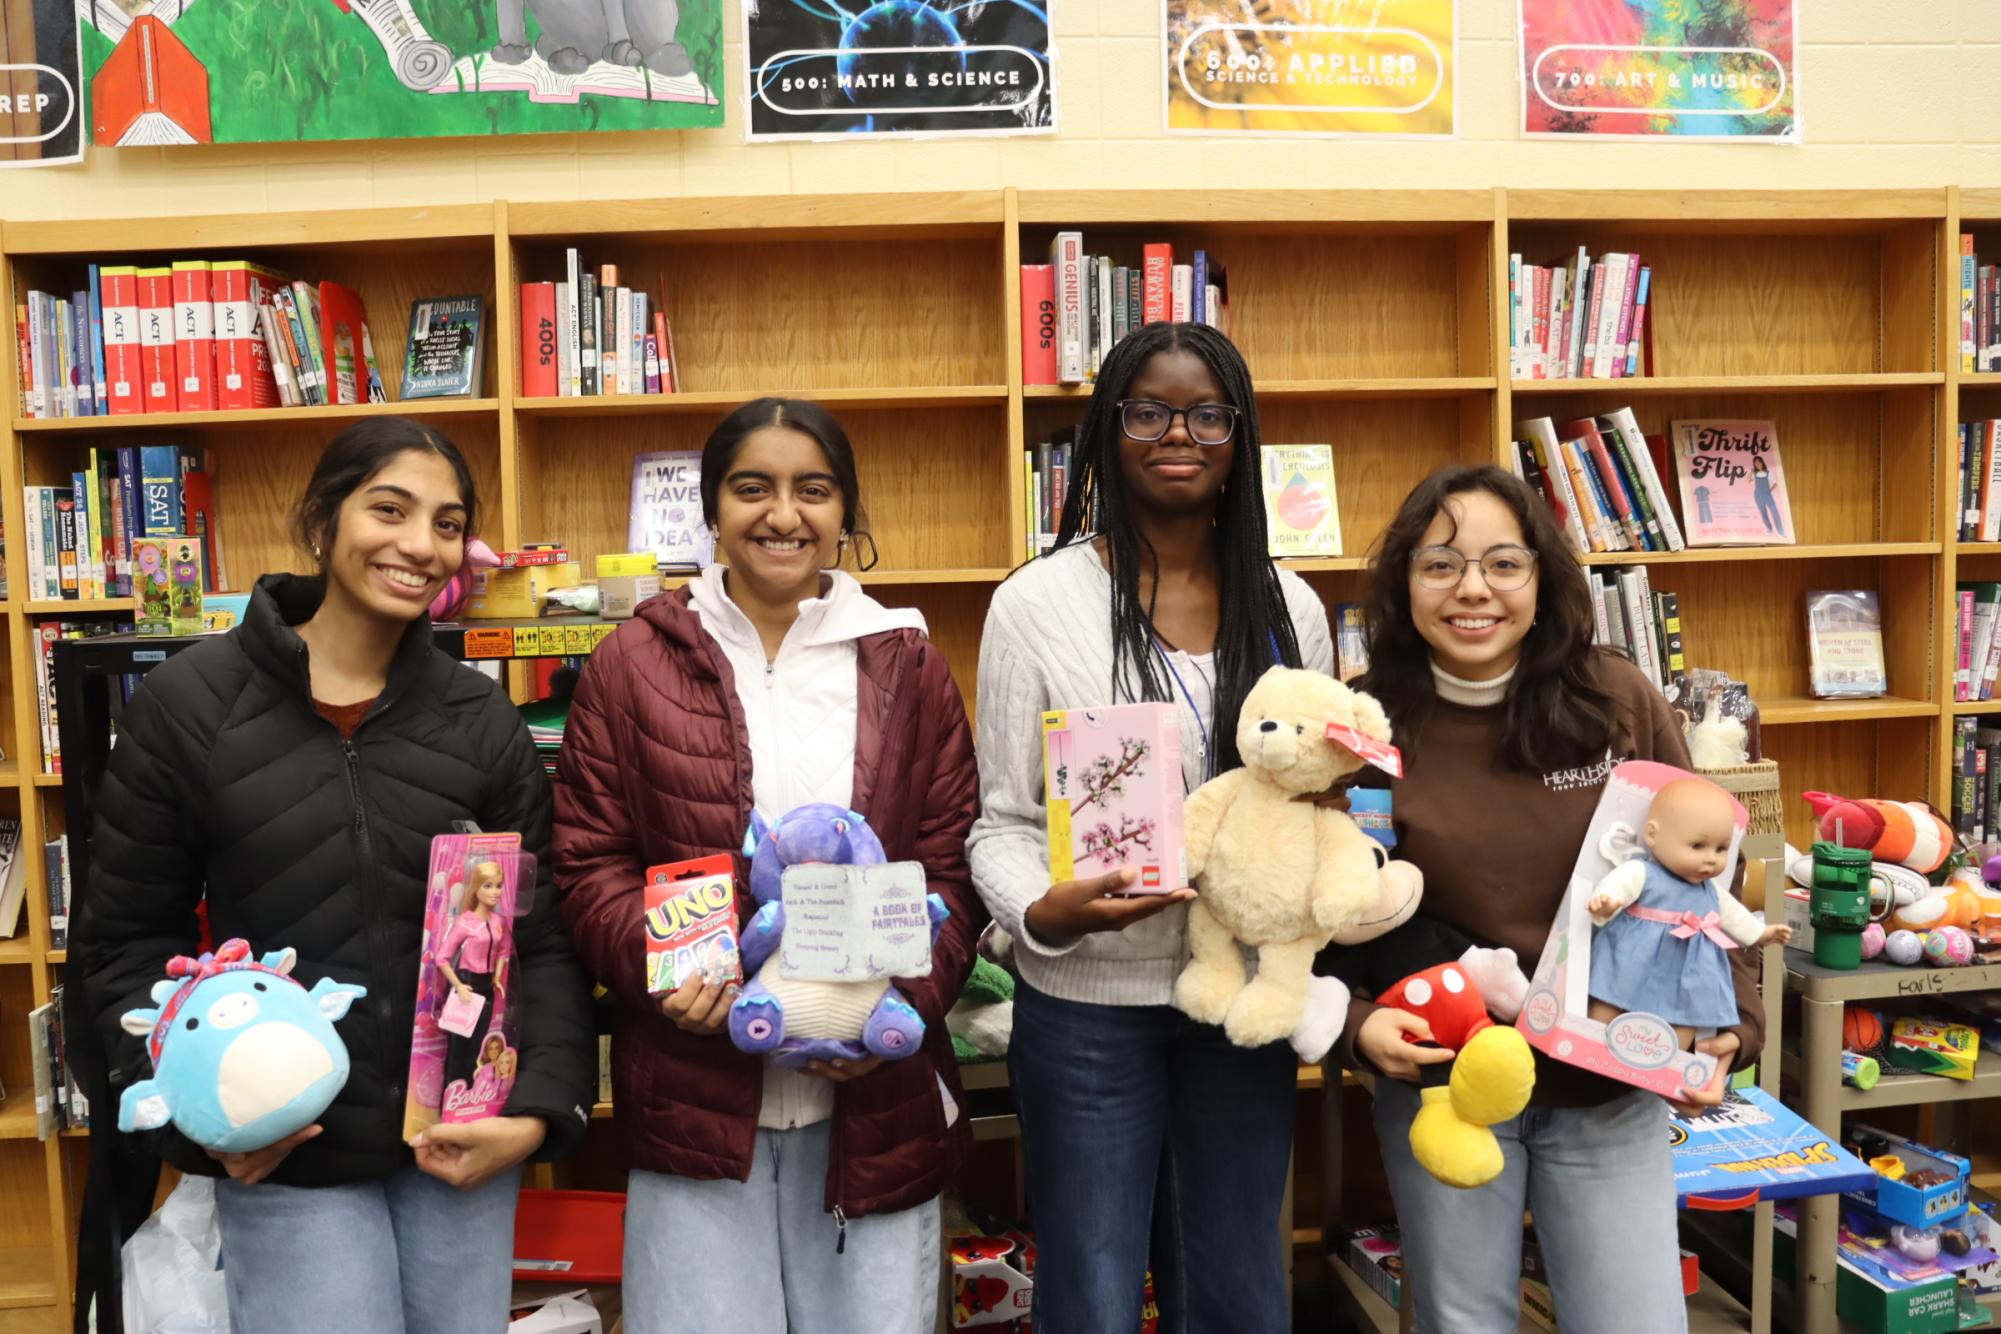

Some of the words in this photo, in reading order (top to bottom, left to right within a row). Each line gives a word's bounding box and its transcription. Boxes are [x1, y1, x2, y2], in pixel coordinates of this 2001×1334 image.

[1288, 53, 1417, 74] APPLIED
[781, 77, 828, 92] 500:
[837, 74, 896, 89] MATH
[905, 73, 919, 88] &
[927, 71, 1021, 87] SCIENCE
[1206, 70, 1279, 84] SCIENCE
[1286, 73, 1297, 84] &
[1304, 73, 1418, 87] TECHNOLOGY
[1554, 72, 1605, 87] 700:
[1615, 73, 1657, 88] ART
[1668, 75, 1681, 88] &
[1691, 74, 1764, 89] MUSIC
[1064, 264, 1079, 311] GENIUS
[416, 299, 477, 316] OUNTABLE
[114, 312, 124, 341] ACT
[150, 312, 160, 342] ACT
[186, 306, 196, 336] ACT
[226, 306, 236, 336] ACT
[1040, 300, 1054, 349] 600s
[1619, 306, 1628, 334] KITCHEN
[77, 318, 87, 363] Newcomers
[538, 318, 554, 366] 400s
[570, 320, 578, 350] ENGLISH
[1698, 427, 1771, 456] Thrift
[124, 474, 132, 488] SAT
[656, 466, 687, 482] WE
[1691, 455, 1747, 486] Flip
[74, 480, 83, 497] ACT
[643, 486, 700, 504] HAVE
[76, 498, 84, 509] 36
[149, 485, 169, 525] SAT
[66, 526, 74, 549] Naked
[644, 529, 693, 547] IDEA
[1274, 534, 1299, 544] JOHN
[1305, 533, 1335, 543] GEEN
[477, 630, 500, 638] WARNING
[1633, 605, 1644, 633] BUILT
[1640, 645, 1649, 669] LAST
[1963, 776, 1972, 814] SOCCER
[645, 878, 734, 942] UNO
[873, 906, 879, 916] A
[882, 904, 907, 916] BOOK
[911, 903, 922, 914] OF
[872, 915, 926, 930] FAIRYTALES
[1615, 1024, 1670, 1052] Sweet
[445, 1081, 496, 1111] Barbie
[1909, 1288, 1953, 1306] LAUNCHER
[1927, 1297, 1955, 1312] SHARK
[1908, 1305, 1926, 1317] CAR
